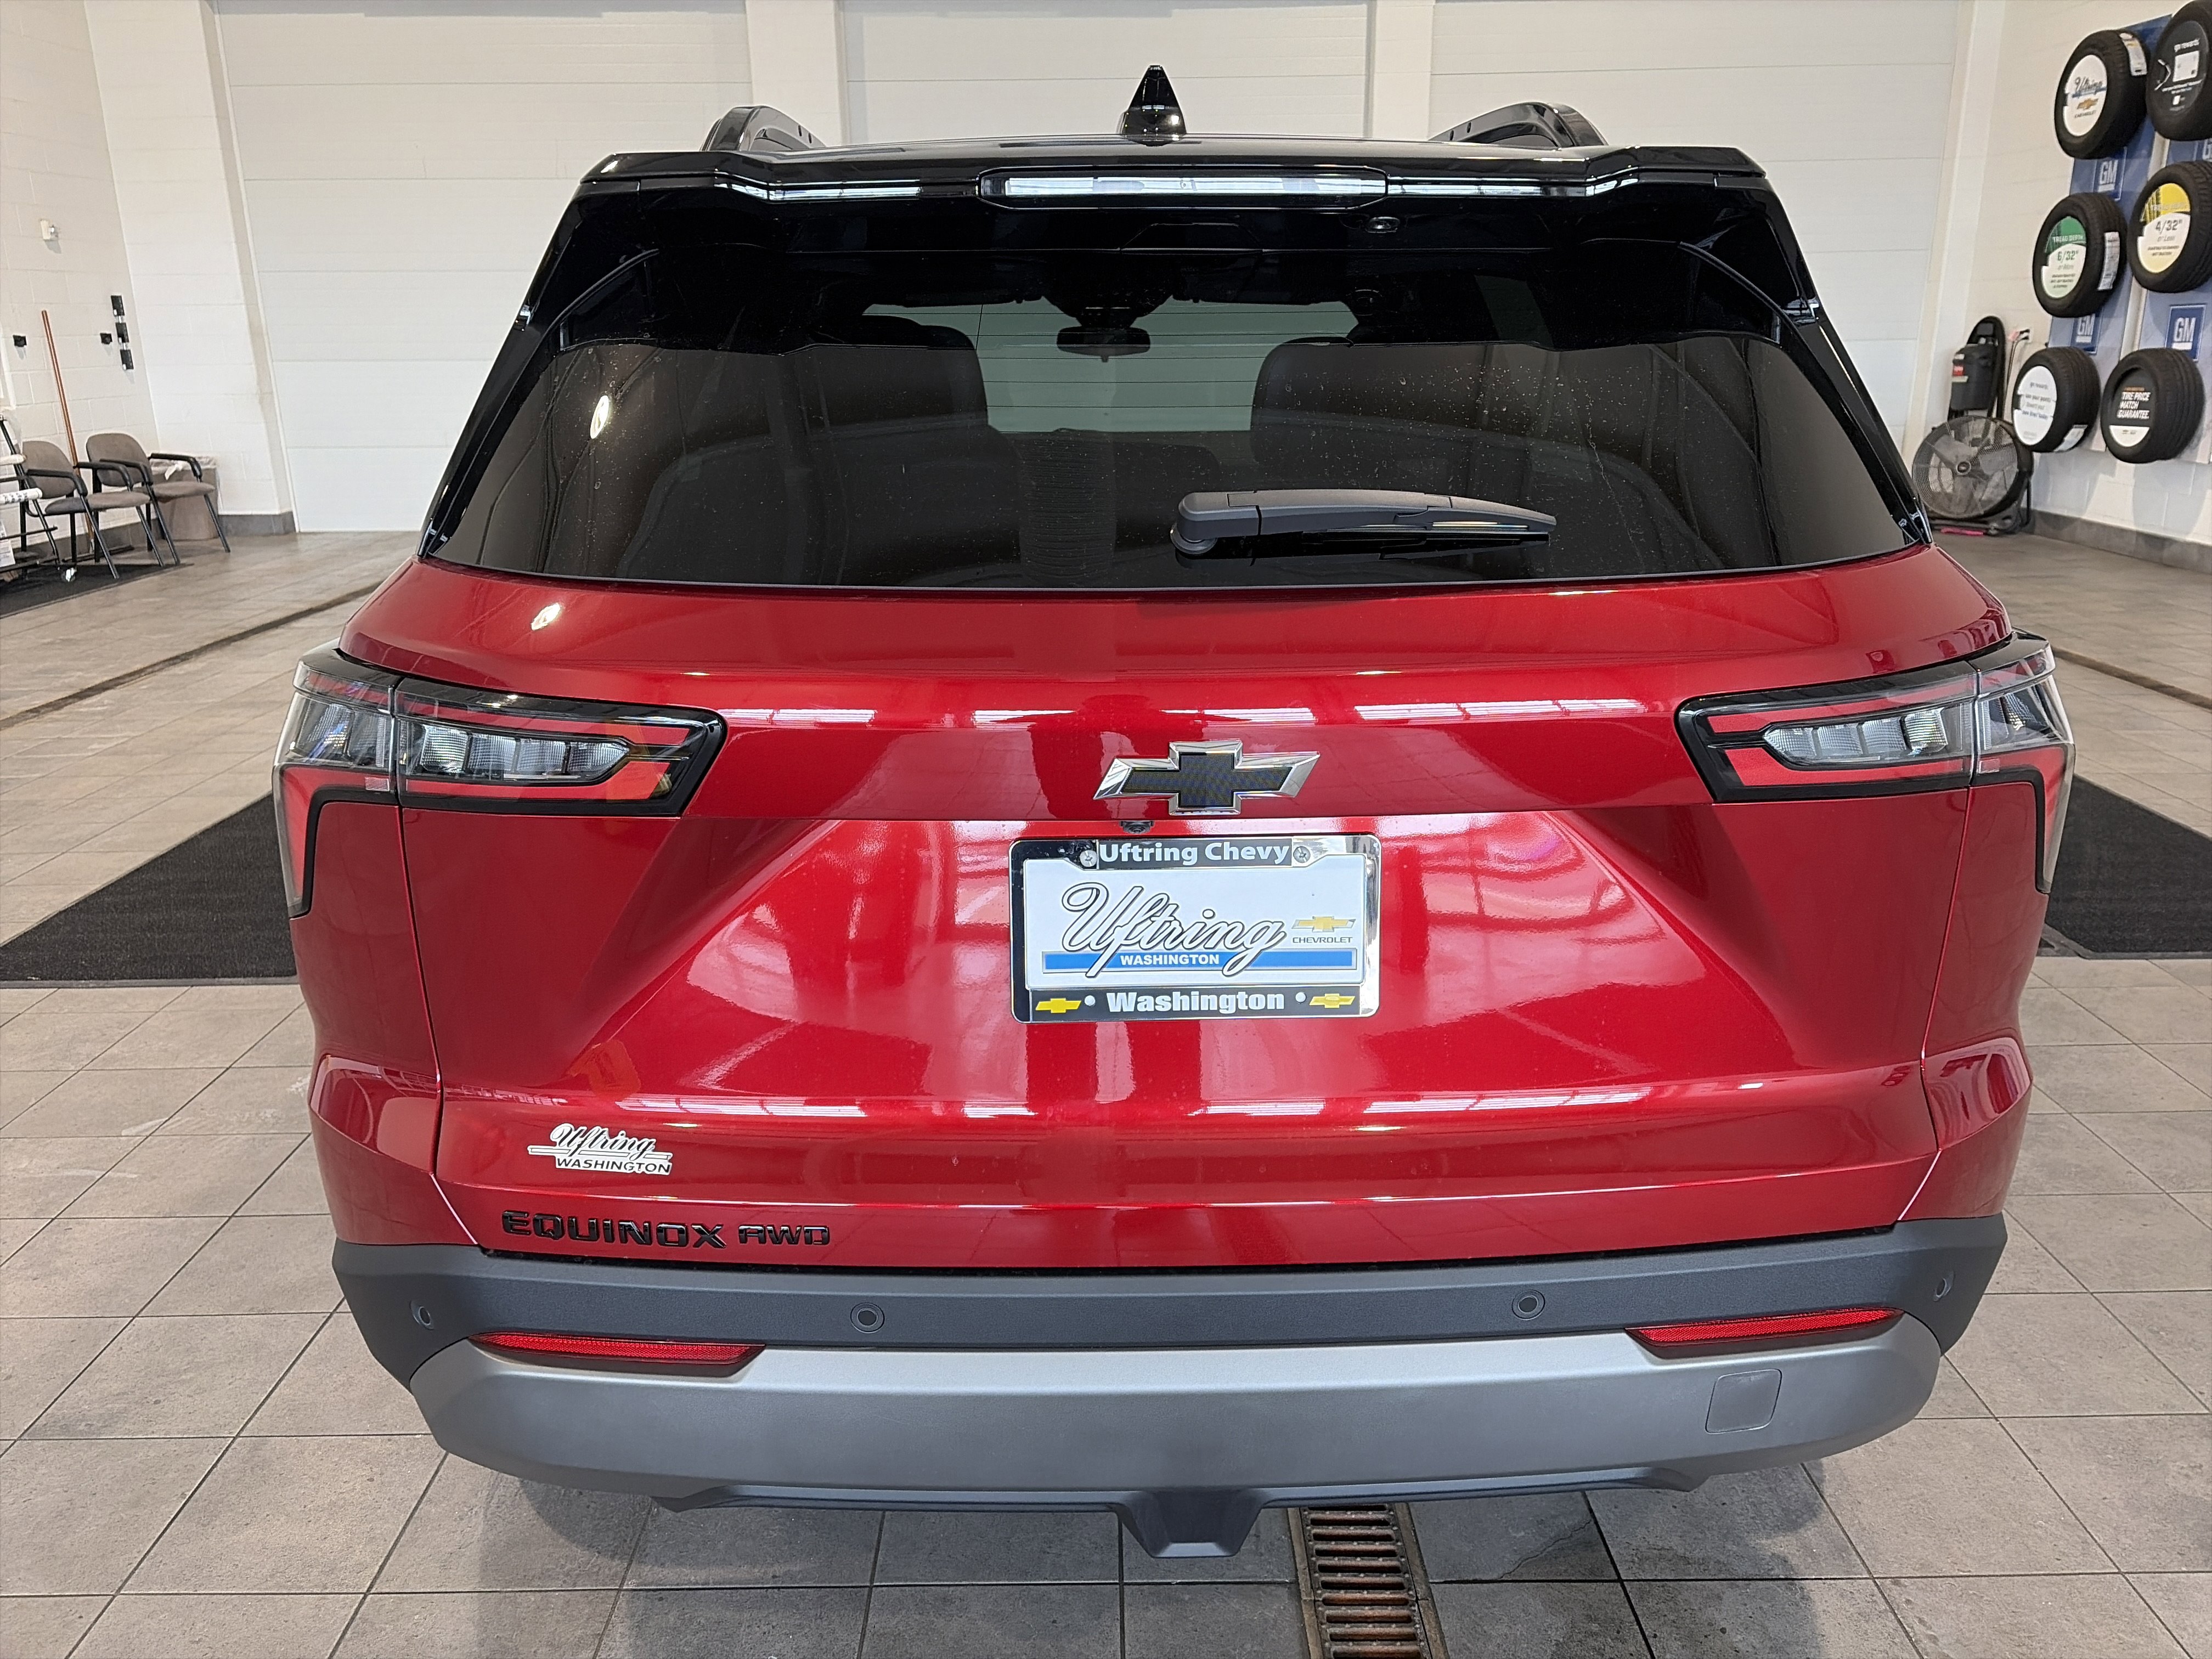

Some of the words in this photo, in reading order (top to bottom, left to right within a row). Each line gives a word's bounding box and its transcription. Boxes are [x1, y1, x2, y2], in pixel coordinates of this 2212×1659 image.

[2174, 317, 2196, 342] GM
[2120, 400, 2139, 409] MATCH
[2122, 392, 2134, 400] TIRE
[2134, 392, 2151, 401] PRICE
[1100, 842, 1197, 865] Uftring
[1206, 842, 1289, 865] Chevy
[1061, 881, 1288, 978] Uftring
[1120, 953, 1220, 966] WASHINGTON
[1107, 991, 1285, 1013] Washington
[551, 1124, 656, 1161] Uftring
[556, 1158, 671, 1173] WASHINGTON
[502, 1210, 726, 1249] EQUINOX
[738, 1224, 830, 1245] AWD
